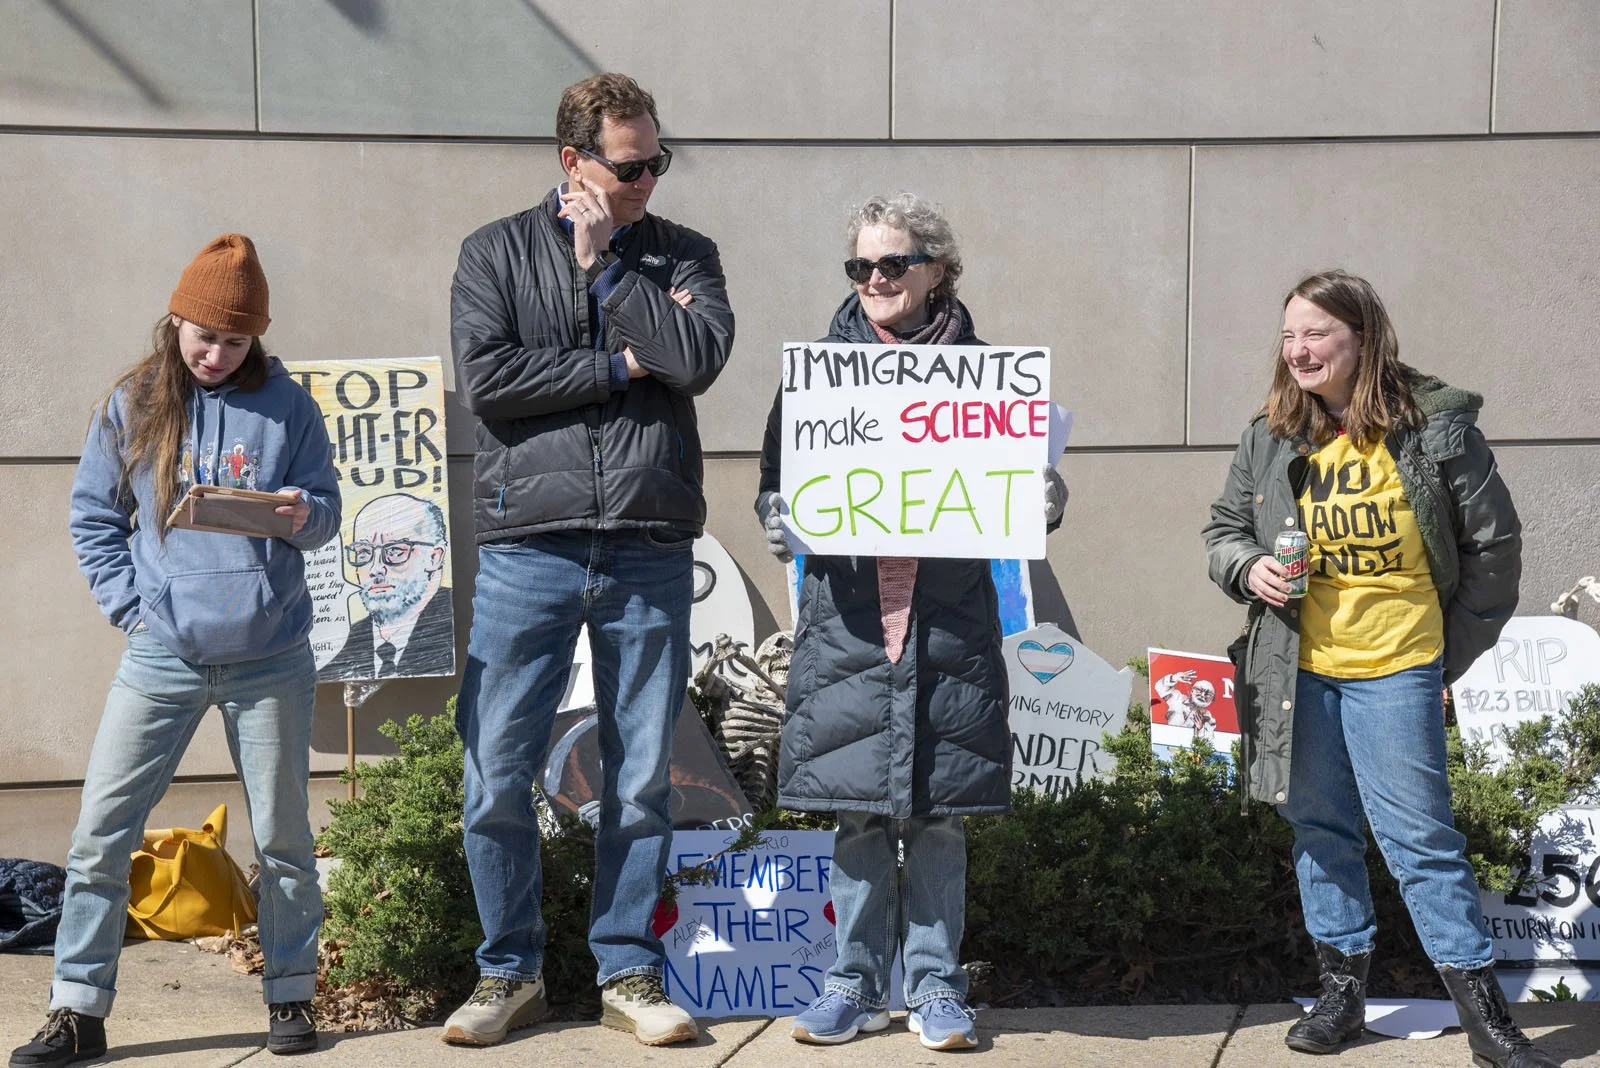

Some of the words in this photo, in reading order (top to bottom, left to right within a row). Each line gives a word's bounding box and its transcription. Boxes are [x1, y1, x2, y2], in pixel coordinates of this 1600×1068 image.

[290, 370, 428, 409] TOP
[783, 347, 1046, 397] IMMIGRANTS
[796, 406, 883, 451] make
[900, 400, 1050, 443] SCIENCE
[334, 466, 442, 492] UD!
[1302, 459, 1372, 503] NO
[791, 468, 1035, 537] GREAT
[1310, 536, 1404, 577] NGS
[1493, 637, 1567, 685] RIP
[1045, 701, 1115, 728] MEMORY
[1515, 688, 1577, 713] BILLIO
[1010, 732, 1102, 774] NDER
[665, 853, 833, 893] EMEMBER
[673, 916, 703, 949] ALEX
[693, 902, 812, 944] THEIR
[1559, 920, 1586, 940] ON
[792, 932, 833, 966] JAIME
[663, 951, 824, 1011] NAMES
